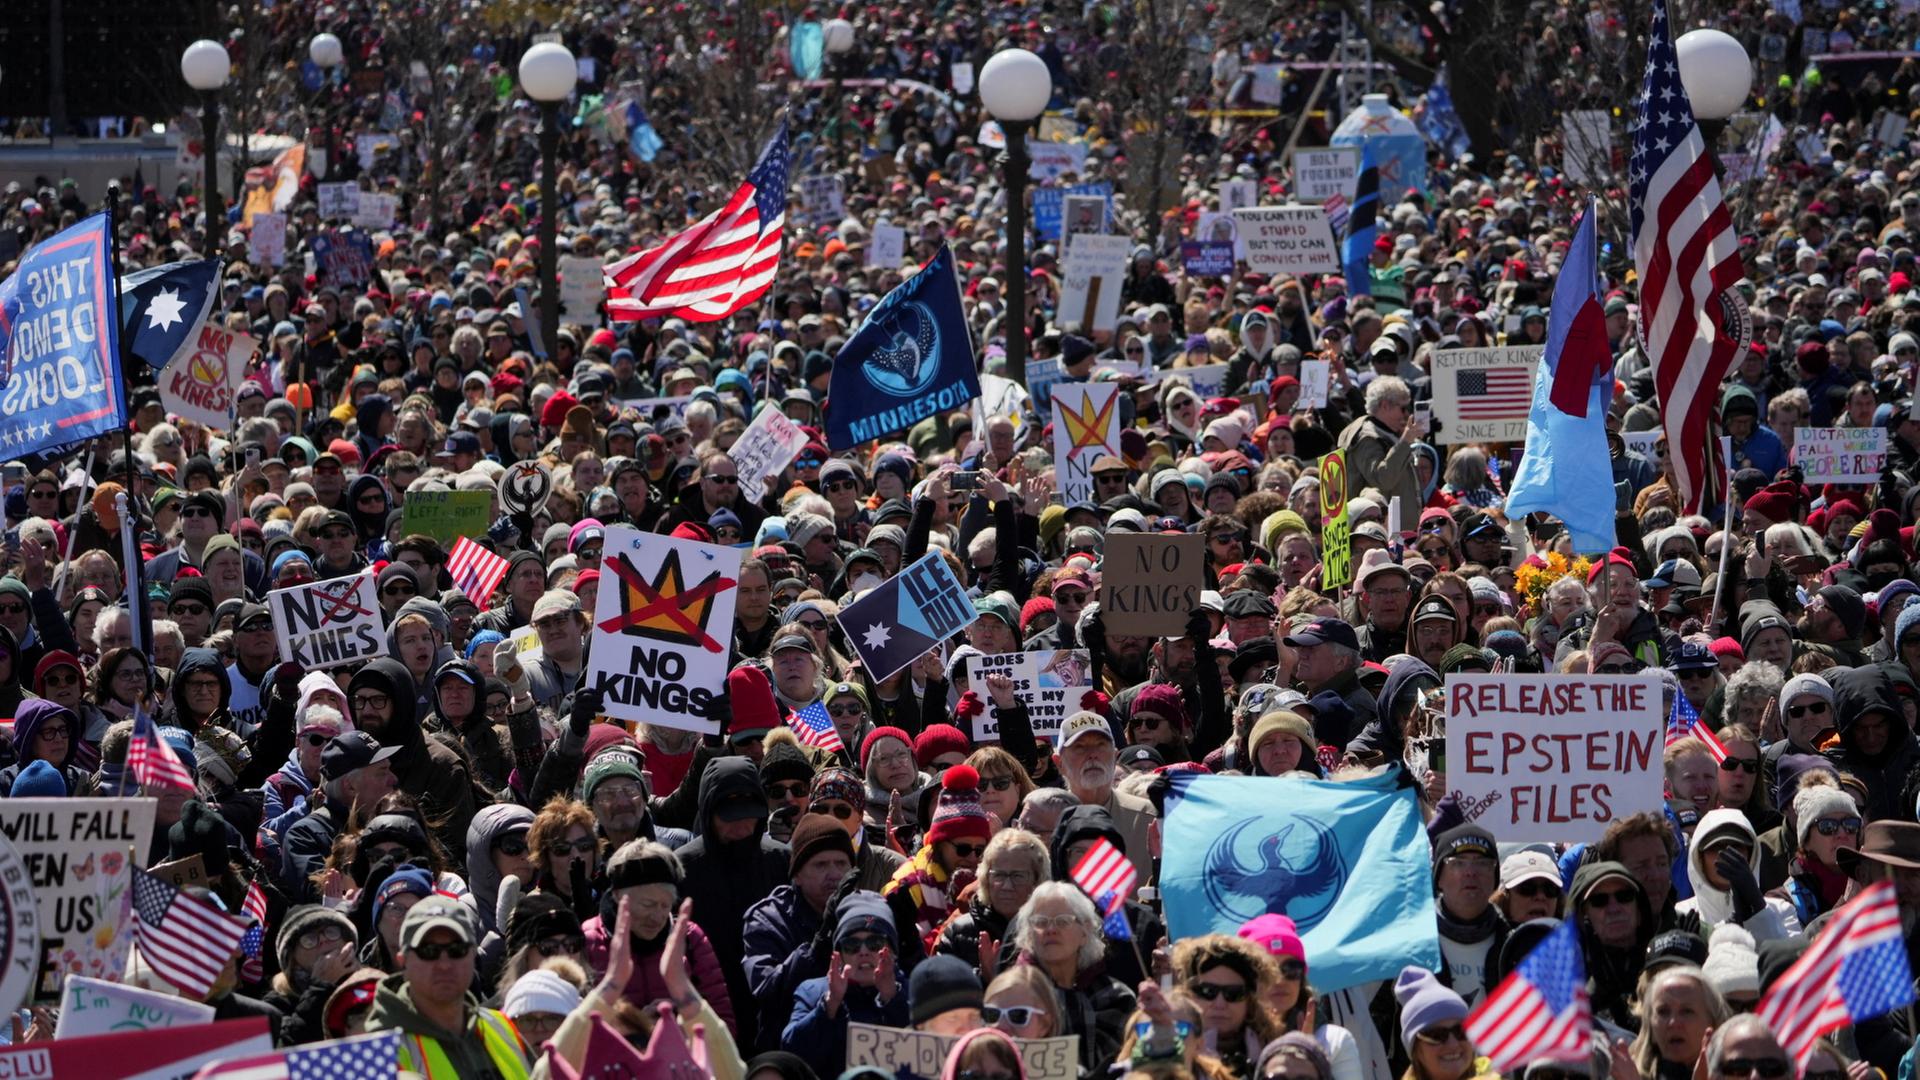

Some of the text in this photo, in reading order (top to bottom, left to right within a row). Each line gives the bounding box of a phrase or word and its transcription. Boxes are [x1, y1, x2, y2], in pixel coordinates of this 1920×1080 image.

[1240, 209, 1318, 222] YOU CAN'T FIX
[1249, 239, 1326, 250] BUT YOU CAN
[1260, 225, 1307, 236] STUPID
[1252, 254, 1332, 265] CONVICT HIM
[1734, 294, 1751, 352] LIBERTY
[197, 326, 234, 355] NO
[1436, 350, 1500, 368] REJECTING
[849, 378, 971, 445] MINNESOTA
[1456, 422, 1496, 440] SINCE
[1801, 428, 1879, 441] DICTATORS
[1798, 443, 1833, 456] FALL
[1798, 453, 1885, 476] PEOPLE RISE
[409, 505, 439, 519] LEFT
[1136, 544, 1180, 573] NO
[900, 554, 955, 609] ICE
[1108, 583, 1197, 613] KINGS
[920, 586, 971, 640] OUT
[289, 622, 379, 667] KINGS
[629, 645, 687, 681] NO
[982, 653, 1025, 667] DOES
[596, 670, 716, 718] KINGS
[1042, 690, 1065, 702] MY
[1451, 682, 1647, 718] RELEASE THE
[1070, 716, 1103, 730] NAVY
[1465, 729, 1658, 775] EPSTEIN
[1510, 783, 1612, 824] FILES
[0, 810, 135, 842] WILL FALL
[2, 852, 35, 973] IBERTY
[55, 896, 94, 934] US
[71, 986, 110, 1012] I'm
[0, 1053, 47, 1079] CLU
